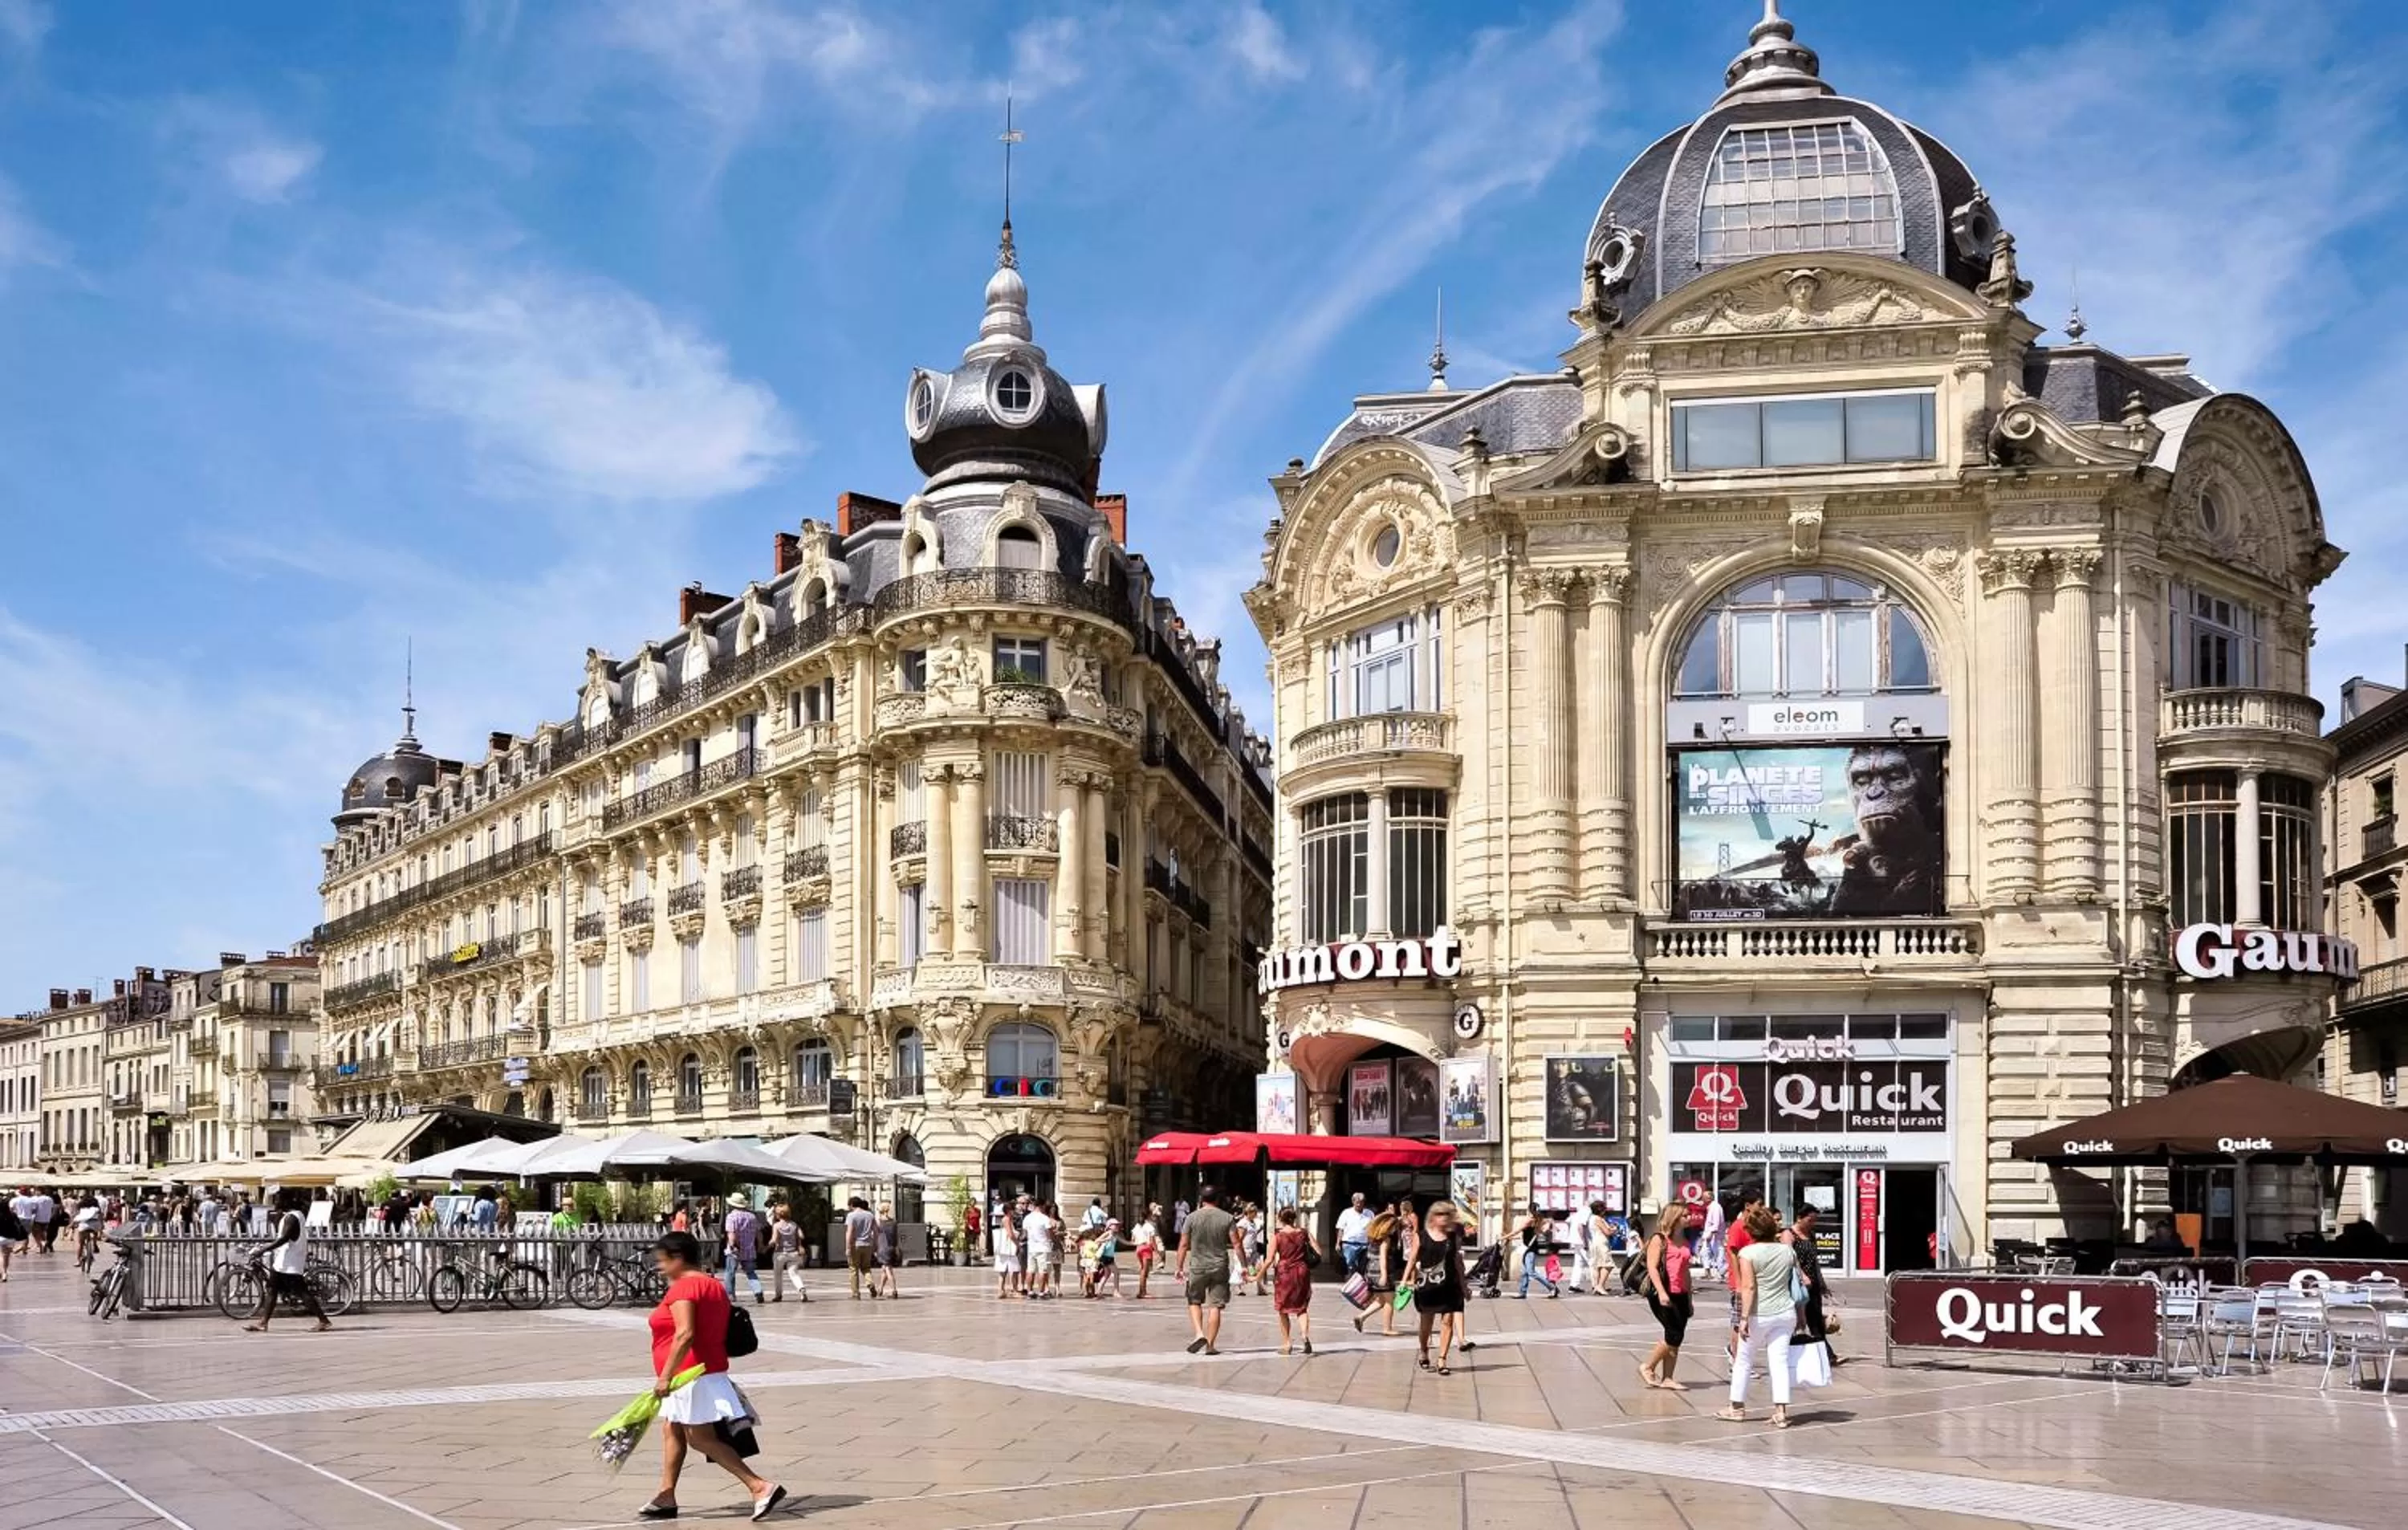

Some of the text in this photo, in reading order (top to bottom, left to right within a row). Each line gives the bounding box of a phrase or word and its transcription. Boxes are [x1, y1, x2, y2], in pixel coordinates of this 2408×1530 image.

[1774, 706, 1838, 723] eleom
[1707, 784, 1824, 804] SINGES
[1689, 804, 1821, 816] L'AFFRONTEMENT
[1459, 1012, 1474, 1031] G
[1278, 1032, 1290, 1048] G
[1765, 1035, 1855, 1063] Quick
[1702, 1072, 1735, 1103] Q
[1774, 1070, 1942, 1119] Quick
[1698, 1112, 1735, 1123] Quick
[1852, 1115, 1943, 1125] Restaurant
[1732, 1143, 1887, 1156] Quality Burger Restaurant
[2064, 1140, 2113, 1154] Quick
[2218, 1137, 2273, 1153] Quick
[1861, 1171, 1876, 1184] Q
[1682, 1182, 1704, 1205] Q
[1815, 1232, 1841, 1240] PLACE
[1935, 1288, 2105, 1343] Quick
